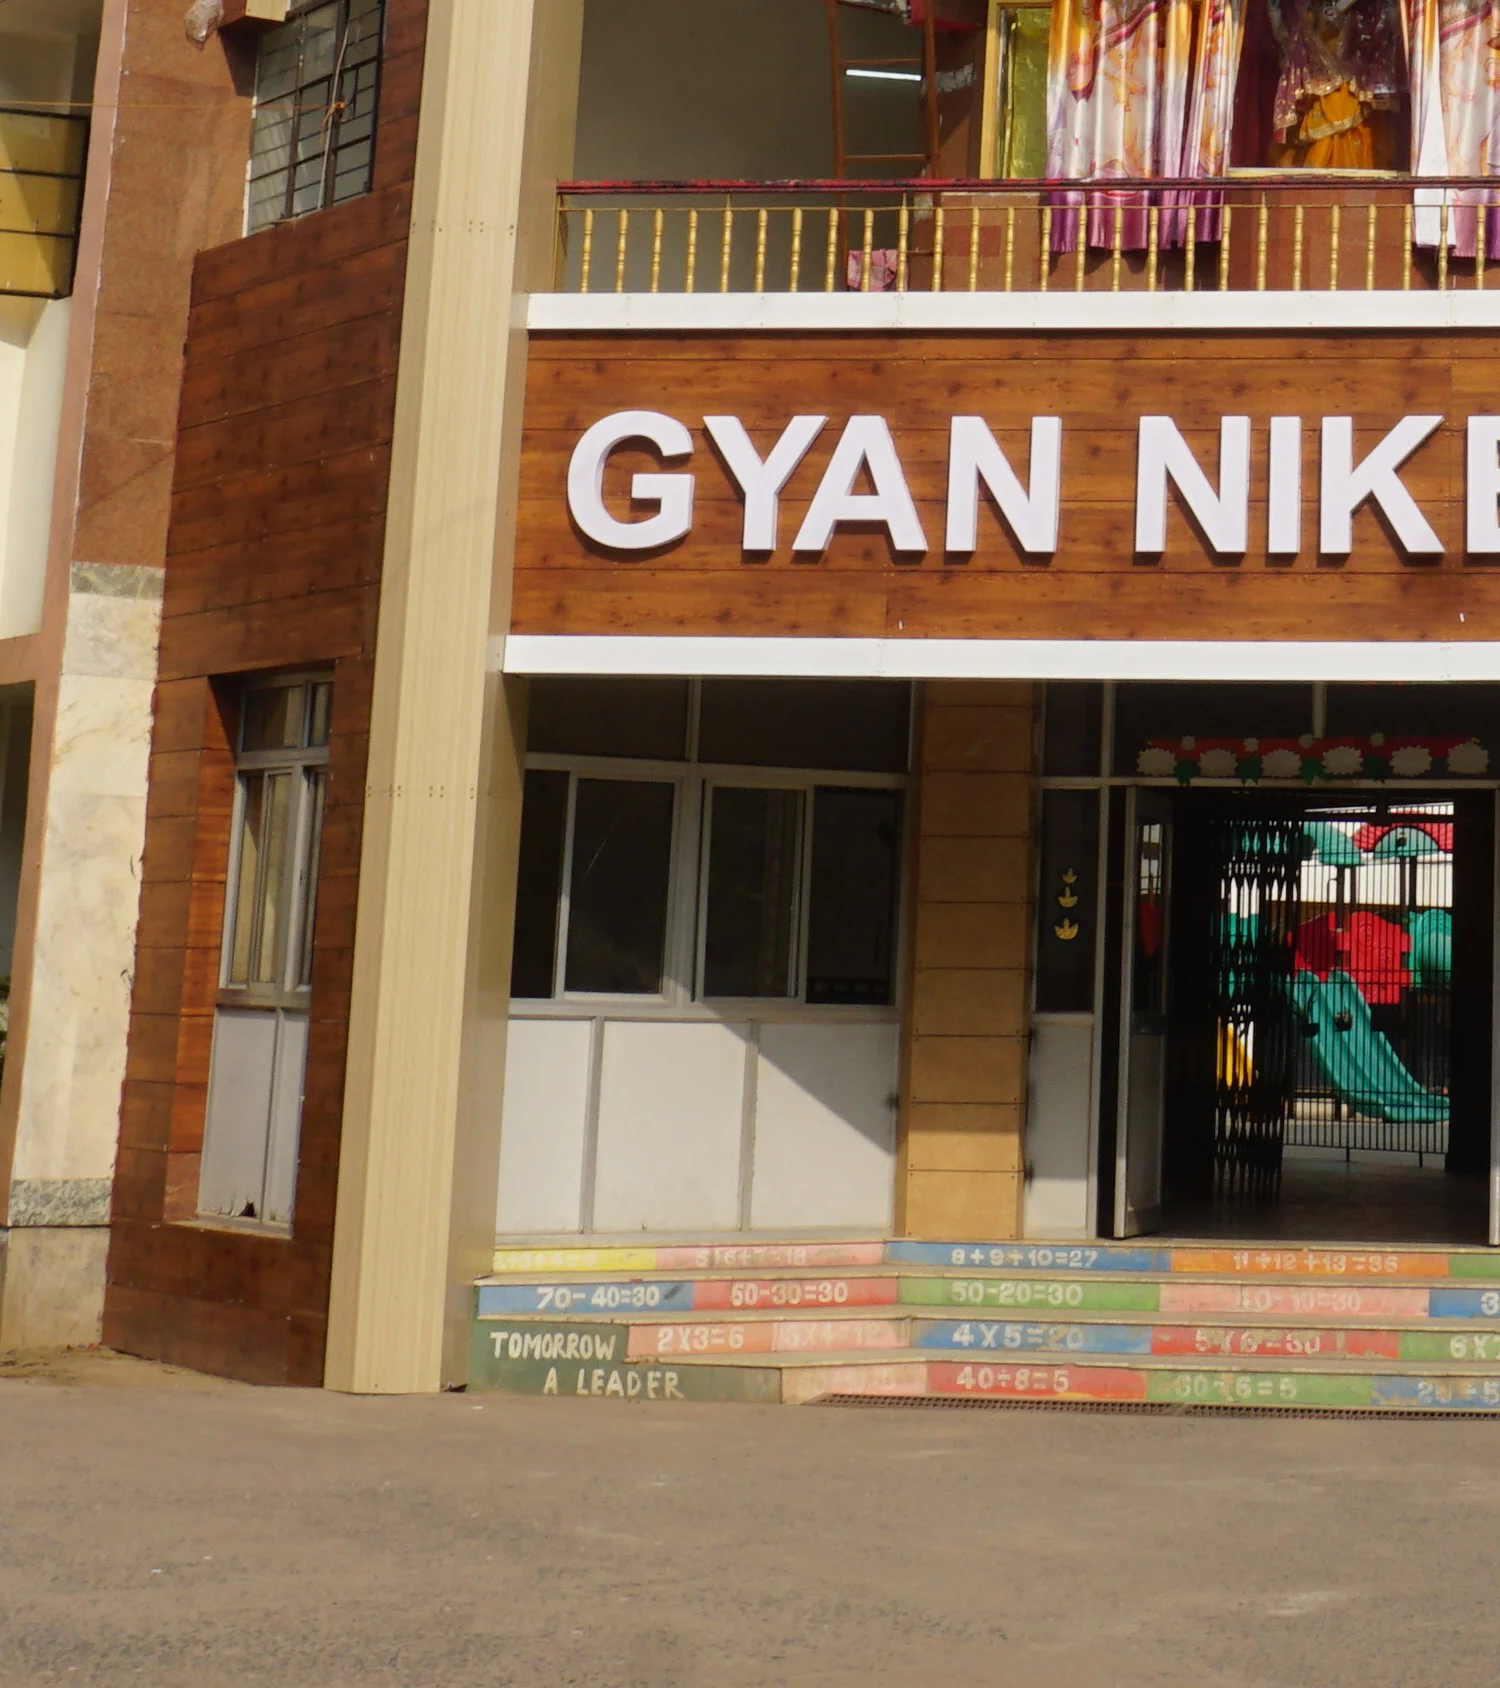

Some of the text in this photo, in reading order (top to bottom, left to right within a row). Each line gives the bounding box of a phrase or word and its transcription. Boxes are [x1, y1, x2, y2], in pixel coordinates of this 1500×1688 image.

[567, 410, 1062, 553] GYAN
[490, 1331, 616, 1361] TOMORROW
[543, 1367, 685, 1399] A LEADER
